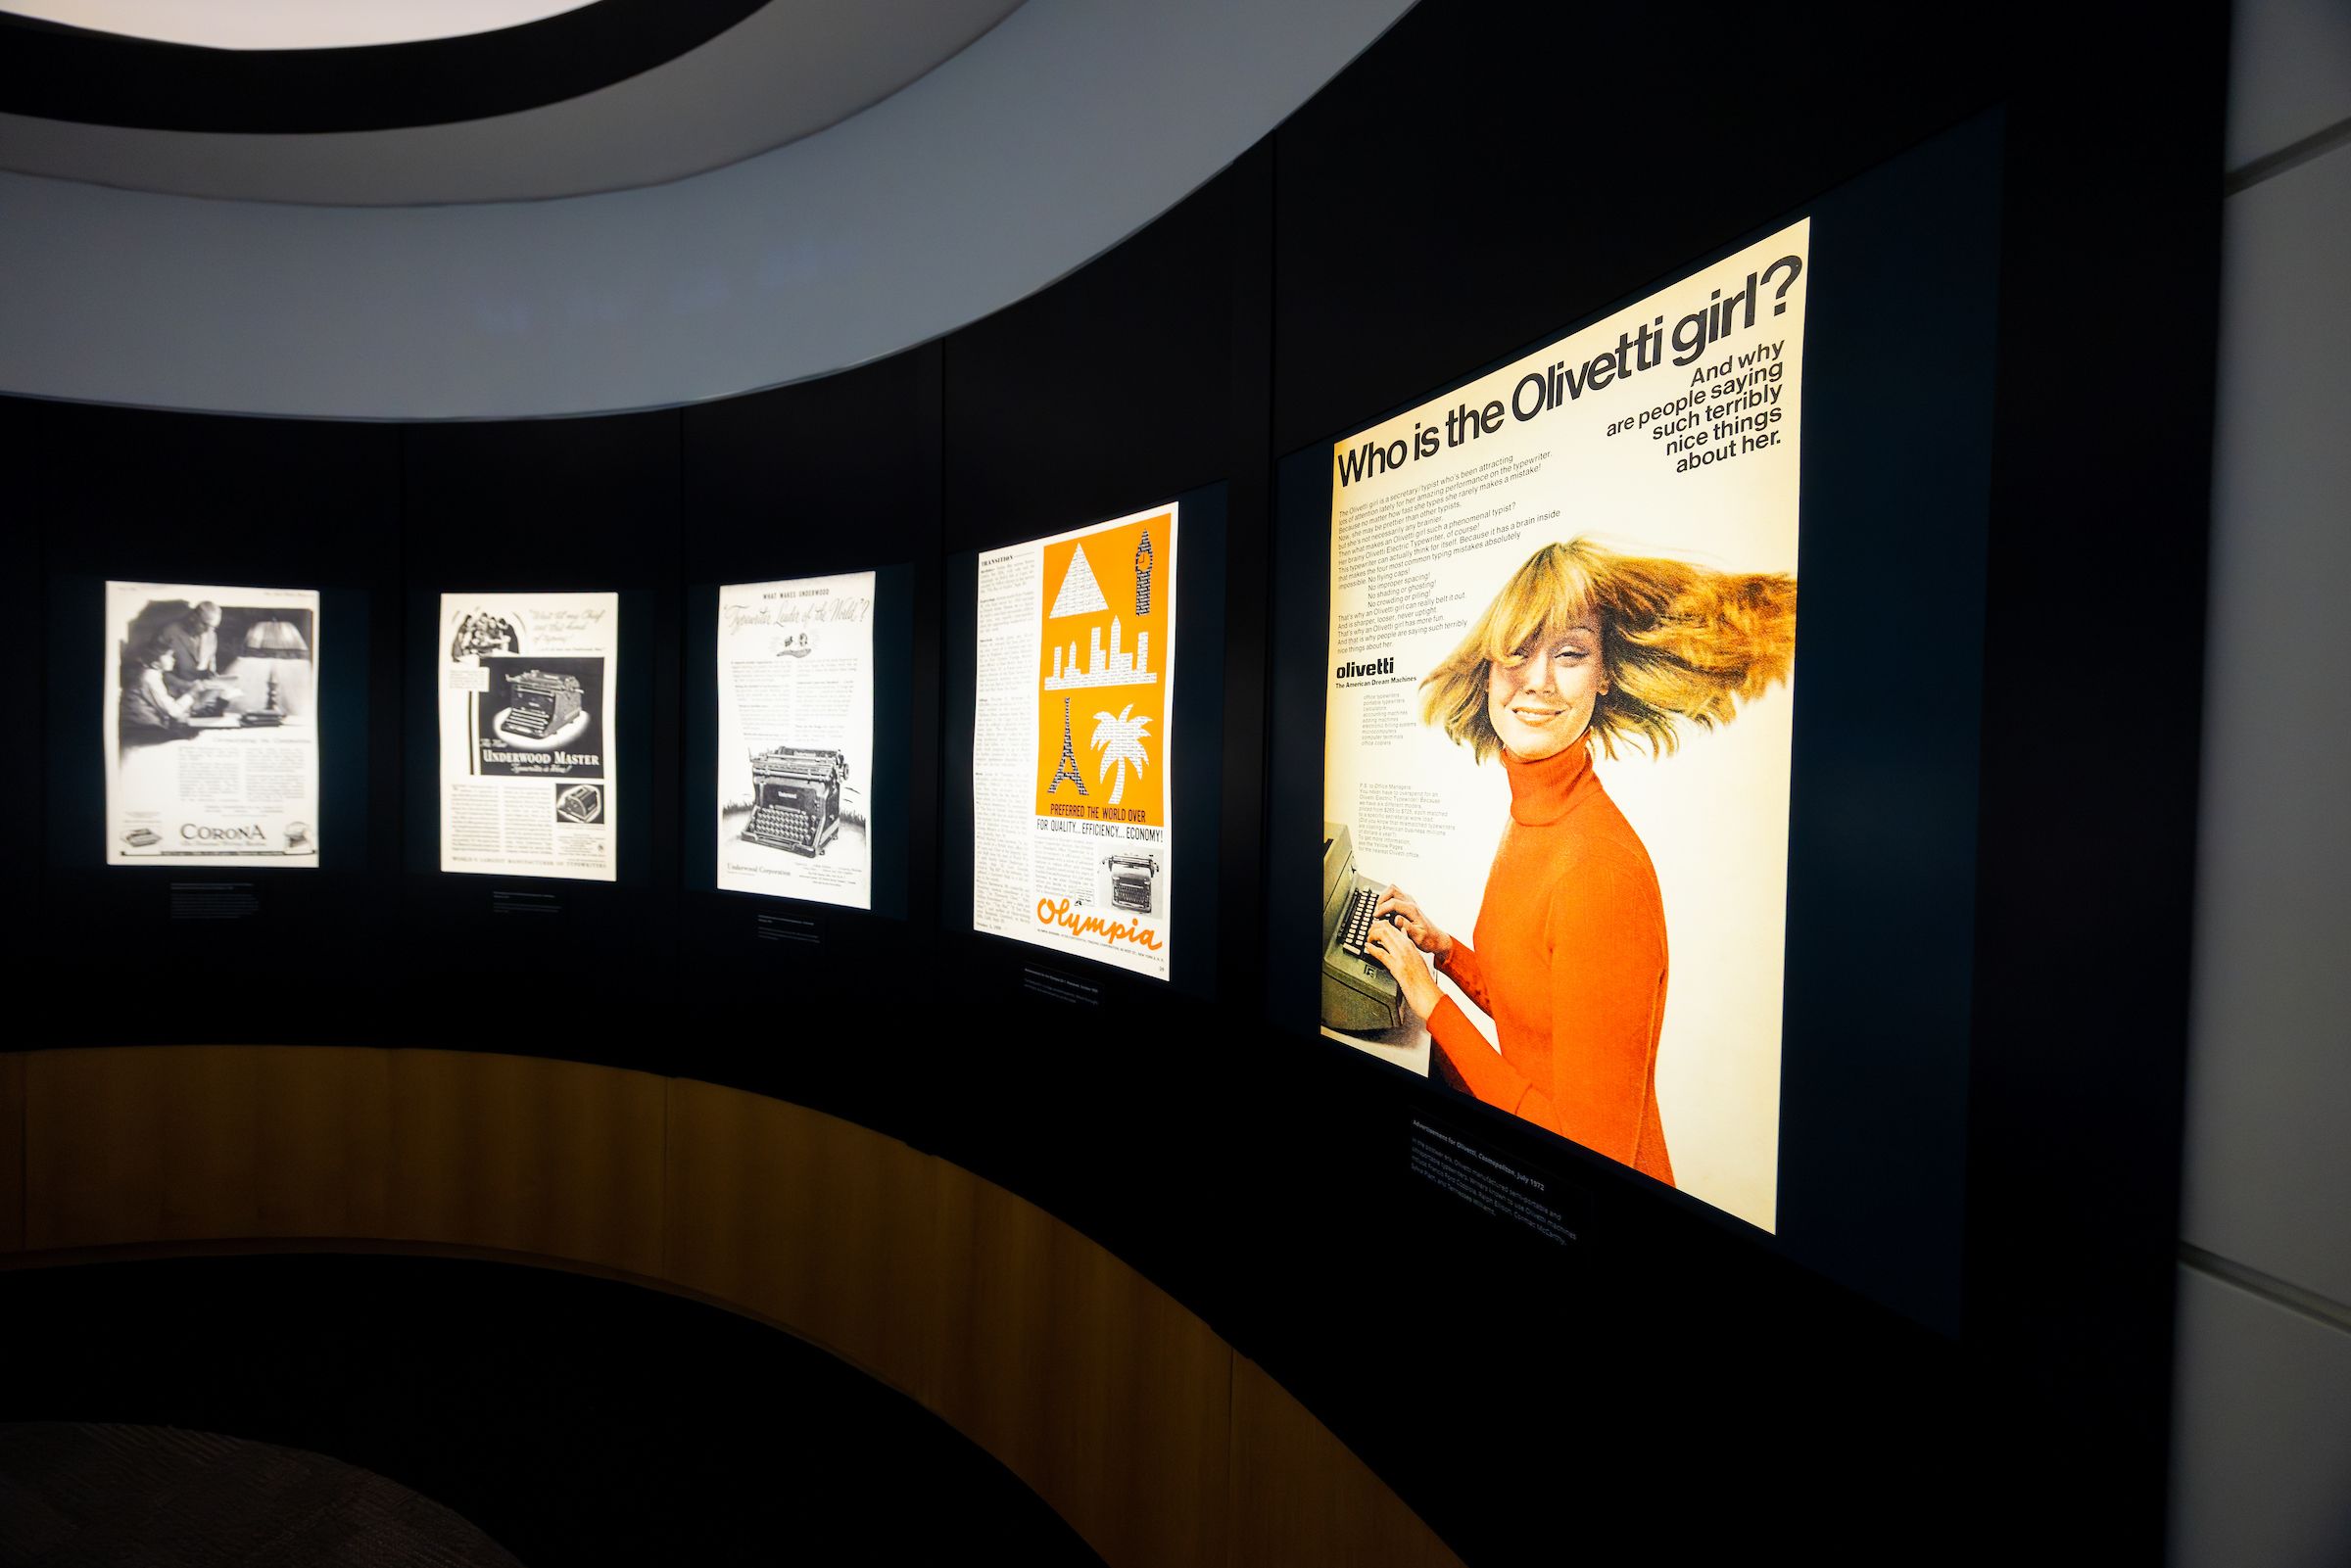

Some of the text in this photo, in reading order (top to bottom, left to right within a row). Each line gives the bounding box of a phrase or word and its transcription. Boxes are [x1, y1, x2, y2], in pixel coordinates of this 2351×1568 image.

[1338, 254, 1802, 487] Who is the Olivetti girl?
[1690, 340, 1785, 387] And why
[1606, 362, 1783, 437] are people saying
[1653, 381, 1782, 442] such terribly
[1666, 406, 1782, 456] nice things
[1676, 429, 1781, 474] about her.
[1460, 467, 1478, 478] been
[1479, 454, 1512, 472] attracting
[1414, 502, 1425, 511] she
[1426, 496, 1443, 508] types
[1445, 492, 1457, 501] she
[1458, 485, 1478, 497] rarely
[1479, 477, 1503, 491] makes
[1510, 462, 1541, 481] mistake!
[1417, 487, 1444, 501] amazing
[1445, 473, 1488, 494] performance
[1500, 464, 1511, 474] the
[1415, 527, 1425, 539] girl
[1427, 523, 1442, 534] such
[1449, 509, 1490, 530] phenomenal
[1492, 500, 1516, 517] typist?
[1420, 508, 1436, 518] other
[1413, 544, 1429, 555] think
[1459, 530, 1488, 544] Because
[1496, 524, 1509, 534] has
[1516, 516, 1535, 528] brain
[1537, 509, 1560, 522] inside
[1454, 522, 1480, 536] course!
[1432, 549, 1451, 561] typing
[1453, 541, 1483, 554] mistakes
[1484, 531, 1520, 546] absolutely
[981, 555, 1013, 567] TRANSITION
[799, 589, 829, 597] UNDERWOOD
[1411, 589, 1430, 601] piling!
[1417, 597, 1434, 607] really
[1435, 594, 1447, 603] belt
[775, 600, 800, 627] Leader
[802, 603, 815, 628] of
[815, 601, 826, 622] the
[1428, 622, 1443, 631] such
[1444, 618, 1467, 629] terribly
[1337, 657, 1394, 679] olivetti
[1391, 676, 1417, 685] Machines
[483, 749, 599, 765] UNDERWOOD MASTER
[1050, 803, 1145, 822] PREFERRED THE WORLD OVER
[180, 823, 266, 840] CORONA
[1037, 819, 1048, 830] FOR
[1126, 827, 1163, 842] ECONOMY!
[727, 863, 758, 872] Underwood
[759, 867, 791, 876] Corporation
[1037, 898, 1163, 950] Olympia
[1517, 1172, 1529, 1184] July
[1530, 1178, 1544, 1191] 1972
